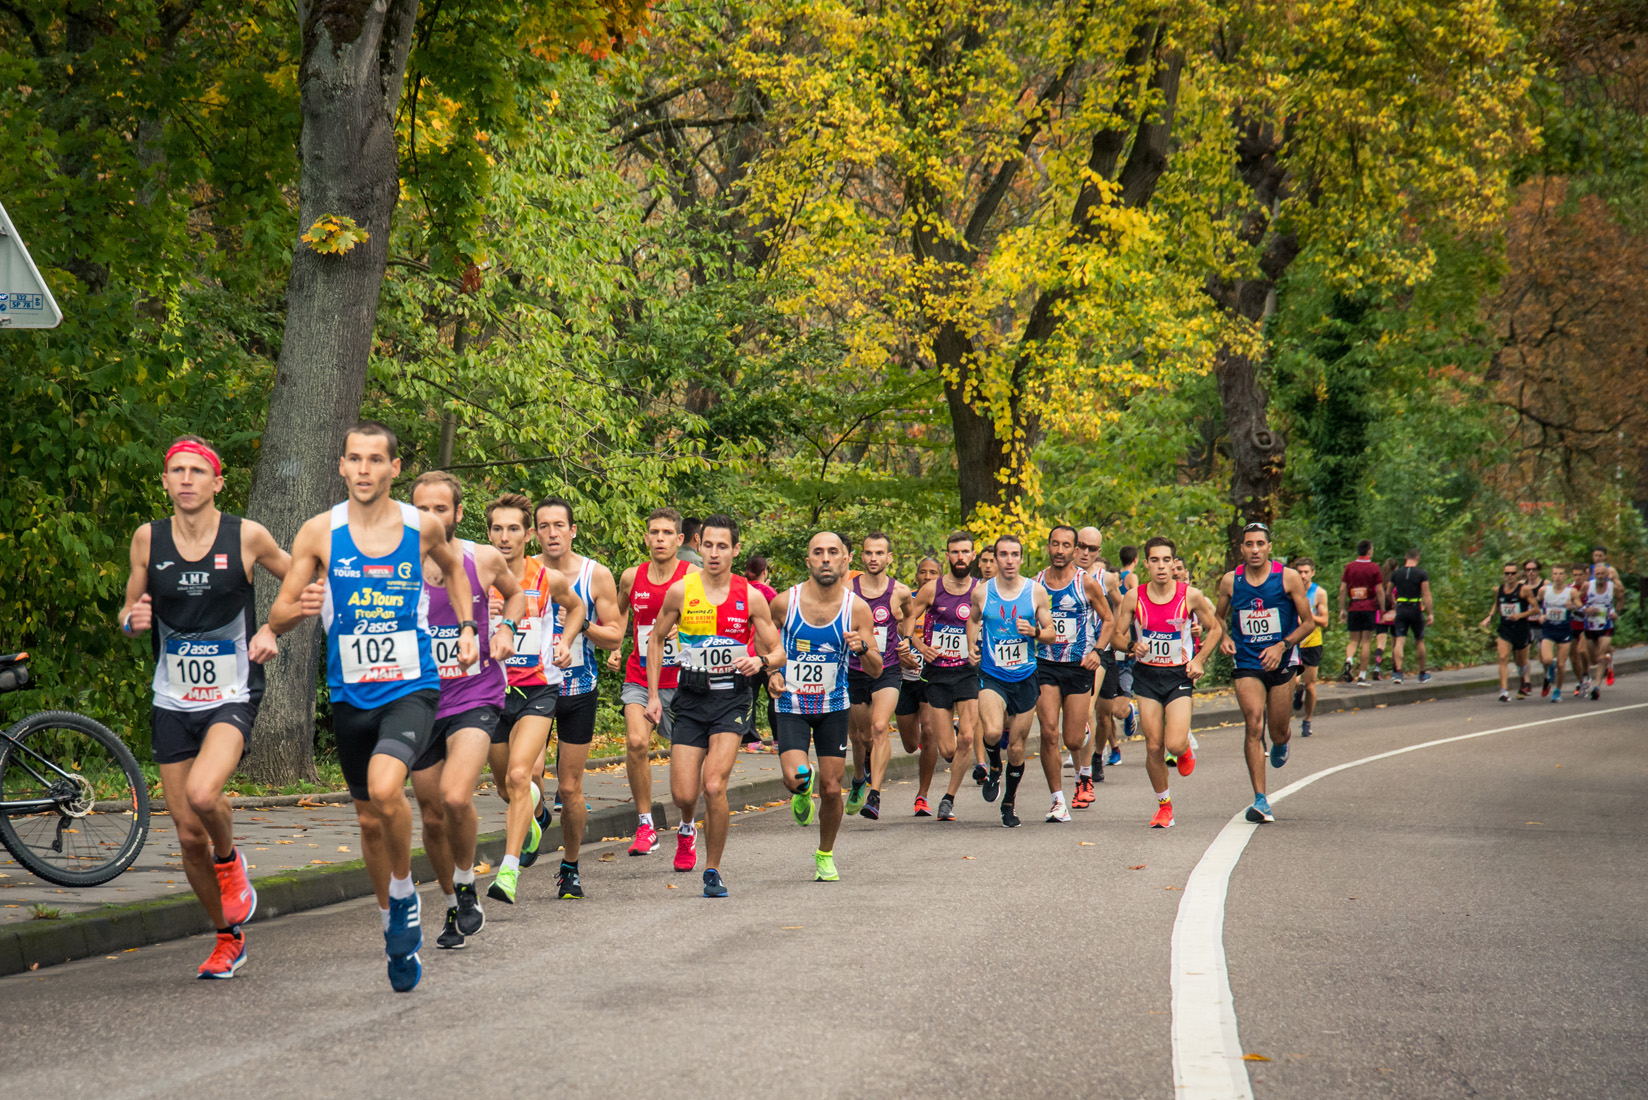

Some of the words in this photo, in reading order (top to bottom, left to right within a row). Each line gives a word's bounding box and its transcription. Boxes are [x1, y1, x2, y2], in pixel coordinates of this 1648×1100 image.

[333, 568, 361, 578] TOURS
[367, 620, 398, 633] asics
[438, 628, 460, 637] asic
[948, 626, 964, 634] asics
[1246, 619, 1269, 634] 109
[713, 637, 735, 646] asics
[938, 634, 961, 650] 116
[1148, 640, 1170, 655] 110
[190, 644, 219, 655] asics
[351, 636, 397, 664] 102
[436, 641, 460, 664] 04
[943, 650, 961, 658] MAIF
[997, 645, 1021, 660] 114
[700, 648, 732, 666] 106
[806, 654, 827, 662] asics
[177, 659, 216, 685] 108
[366, 668, 402, 681] MAIF
[794, 663, 823, 682] 128
[188, 688, 221, 700] MAIF
[800, 684, 825, 693] MAIF
